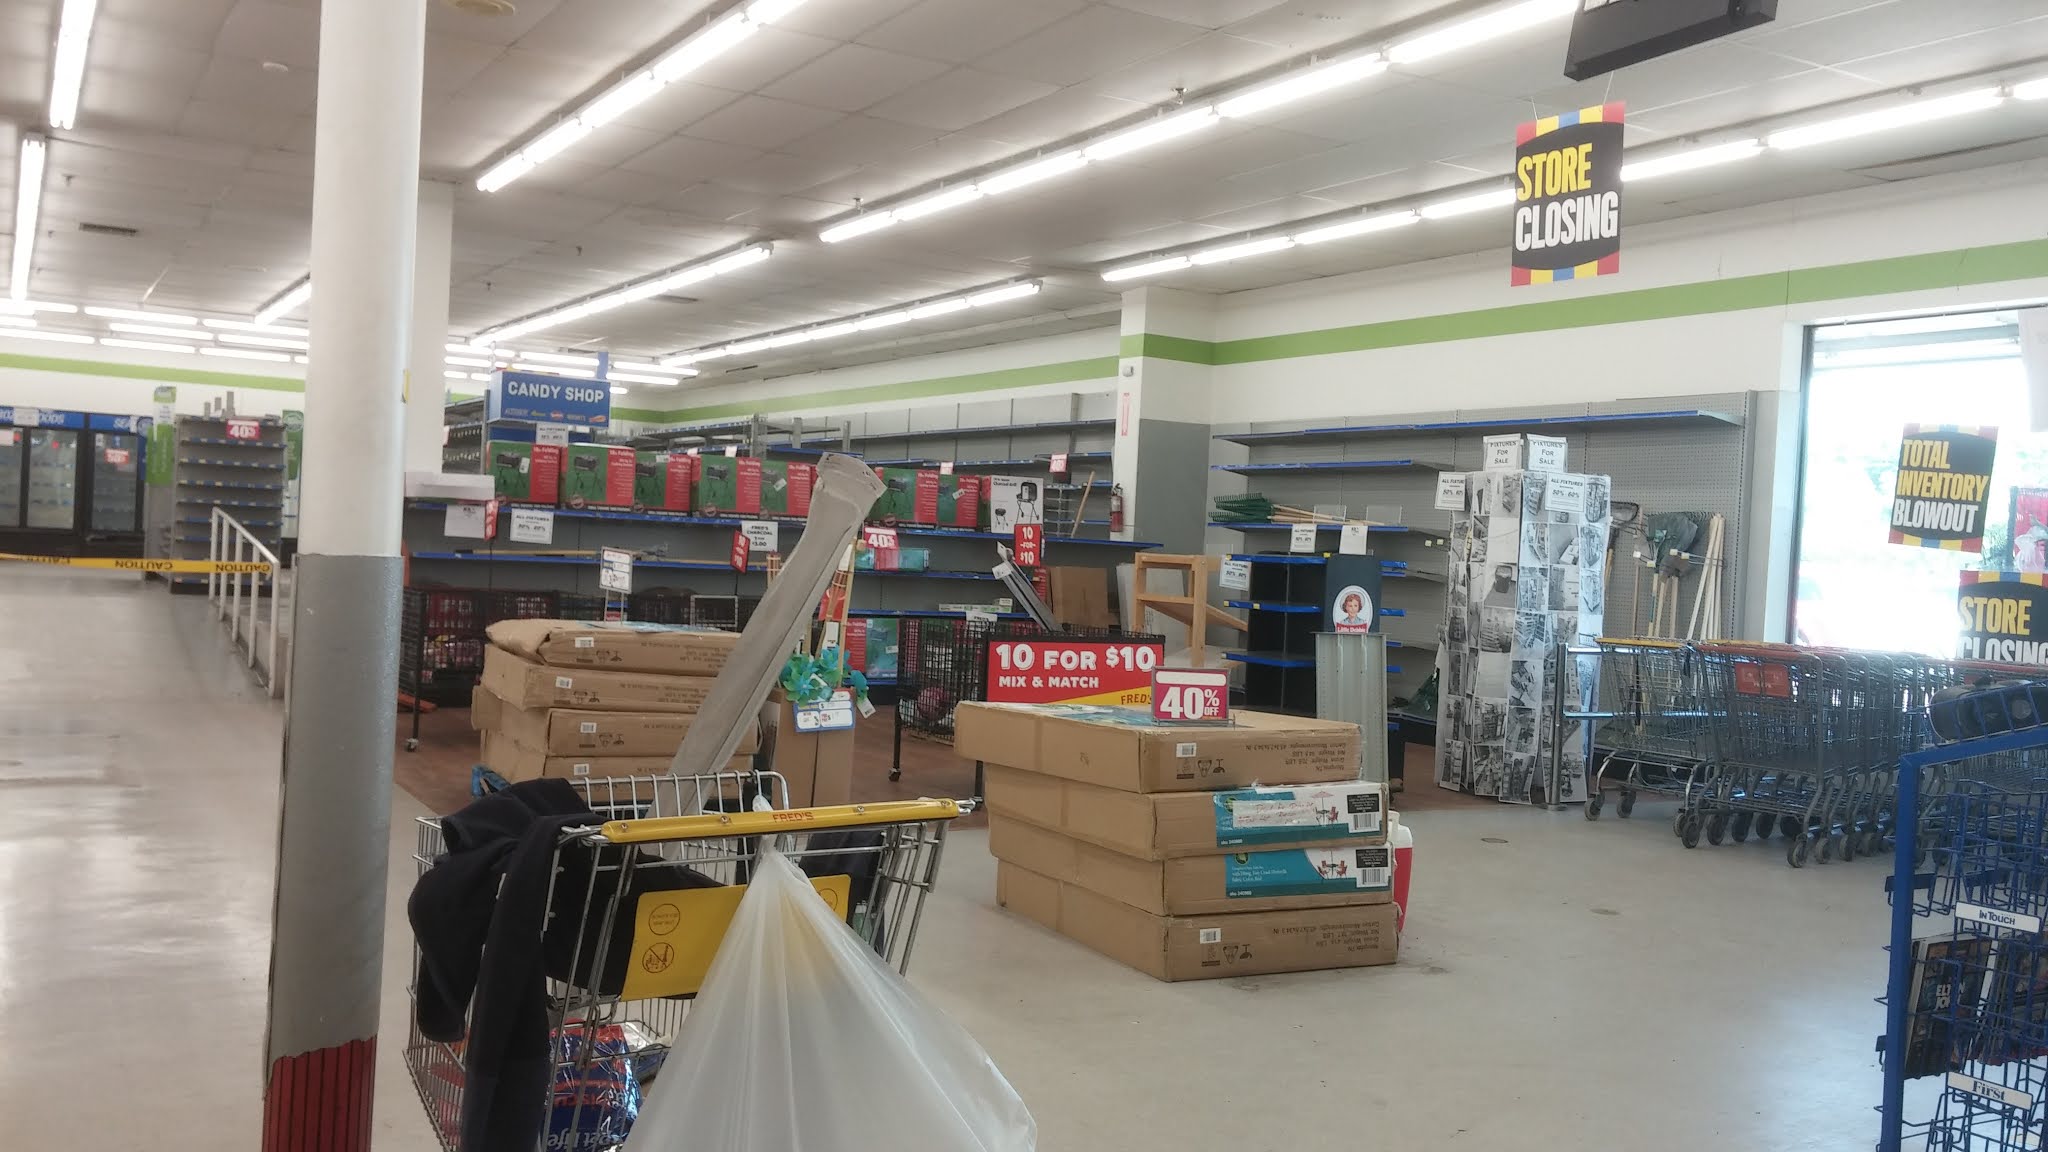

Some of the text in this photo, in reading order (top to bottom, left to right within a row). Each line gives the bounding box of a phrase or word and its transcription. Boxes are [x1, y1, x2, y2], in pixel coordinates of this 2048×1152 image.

[1517, 143, 1593, 202] STORE
[1515, 191, 1619, 252] CLOSING
[508, 381, 604, 403] CANDY SHOP
[1902, 439, 1951, 470] TOTAL
[1897, 471, 1989, 503] INVENTORY
[1892, 499, 1979, 533] BLOWOUT
[1022, 526, 1034, 540] 10
[115, 559, 173, 570] CAUTION
[216, 562, 270, 573] CAUTION
[1020, 551, 1034, 565] $10
[1959, 596, 2032, 636] STORE
[996, 644, 1157, 672] 10 FOR $10
[999, 676, 1099, 688] MIX & MATCH
[1204, 706, 1219, 716] OFF
[773, 812, 814, 823] FRED'S
[1936, 982, 1966, 996] ELTN
[1972, 1080, 2005, 1101] First
